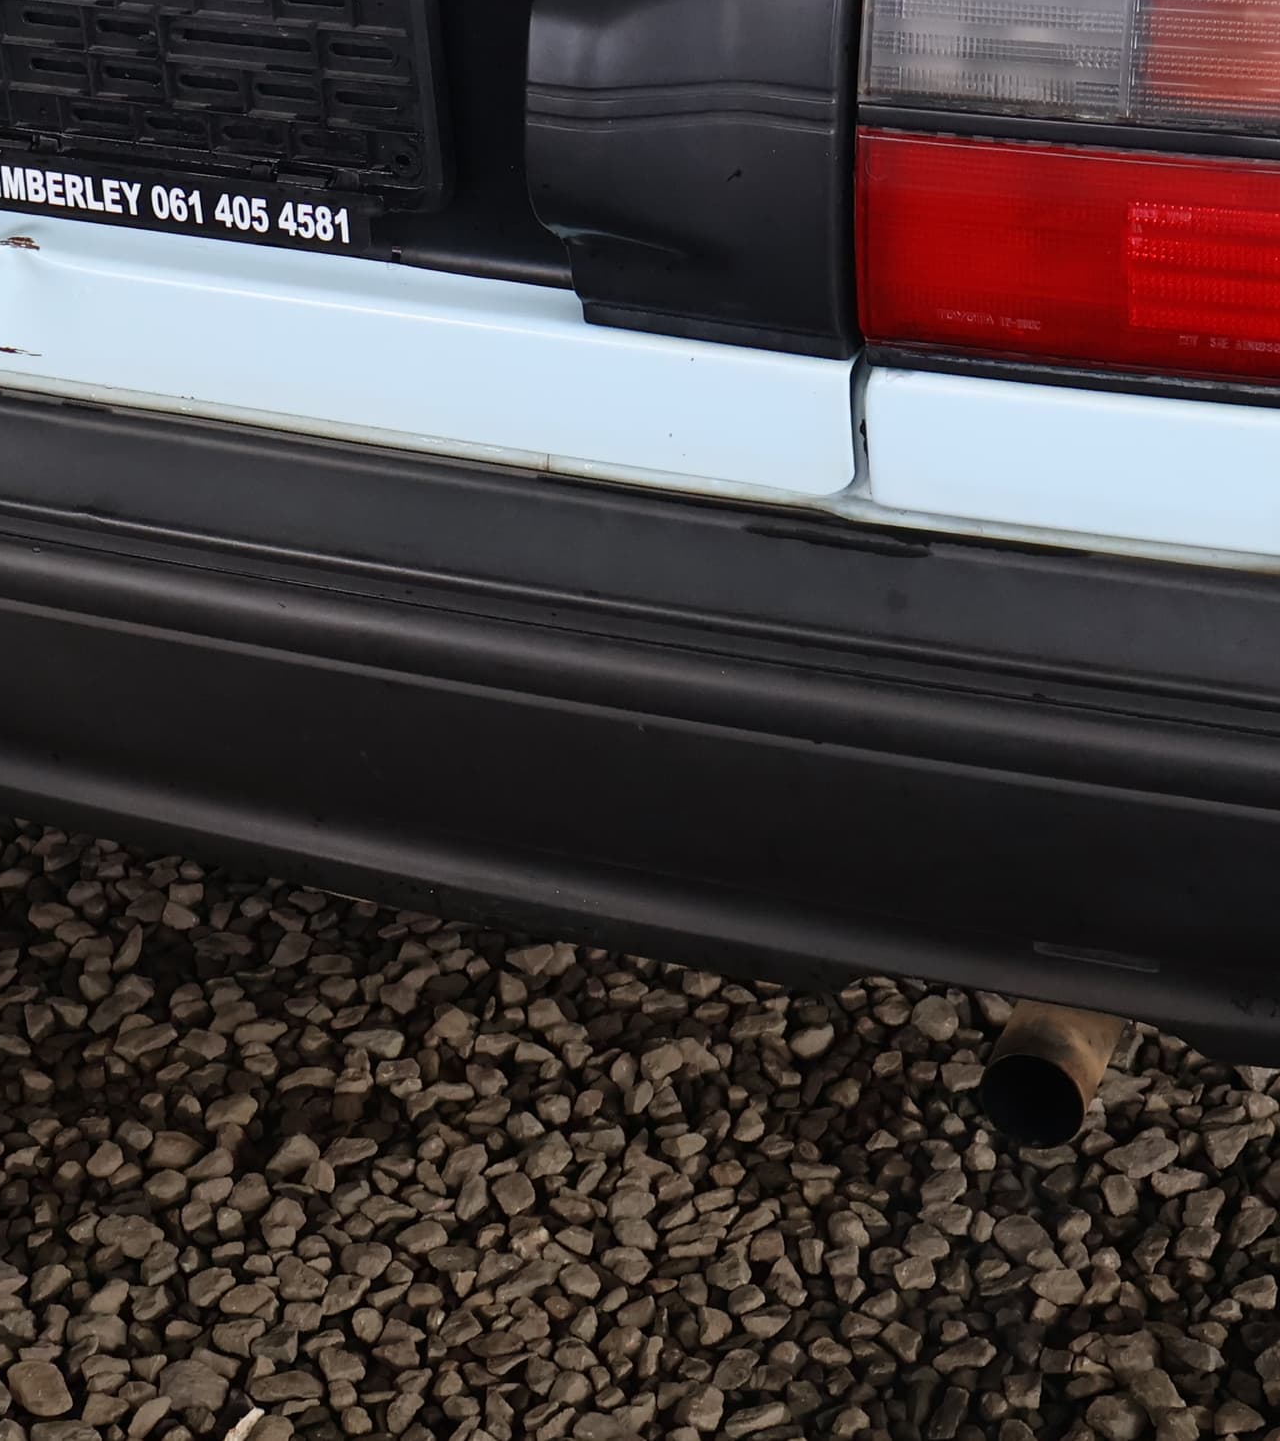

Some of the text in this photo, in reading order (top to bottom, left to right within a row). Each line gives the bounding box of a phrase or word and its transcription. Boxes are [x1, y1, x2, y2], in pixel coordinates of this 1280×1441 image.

[151, 185, 204, 224] 061
[215, 193, 269, 233] 405
[278, 201, 351, 244] 4581
